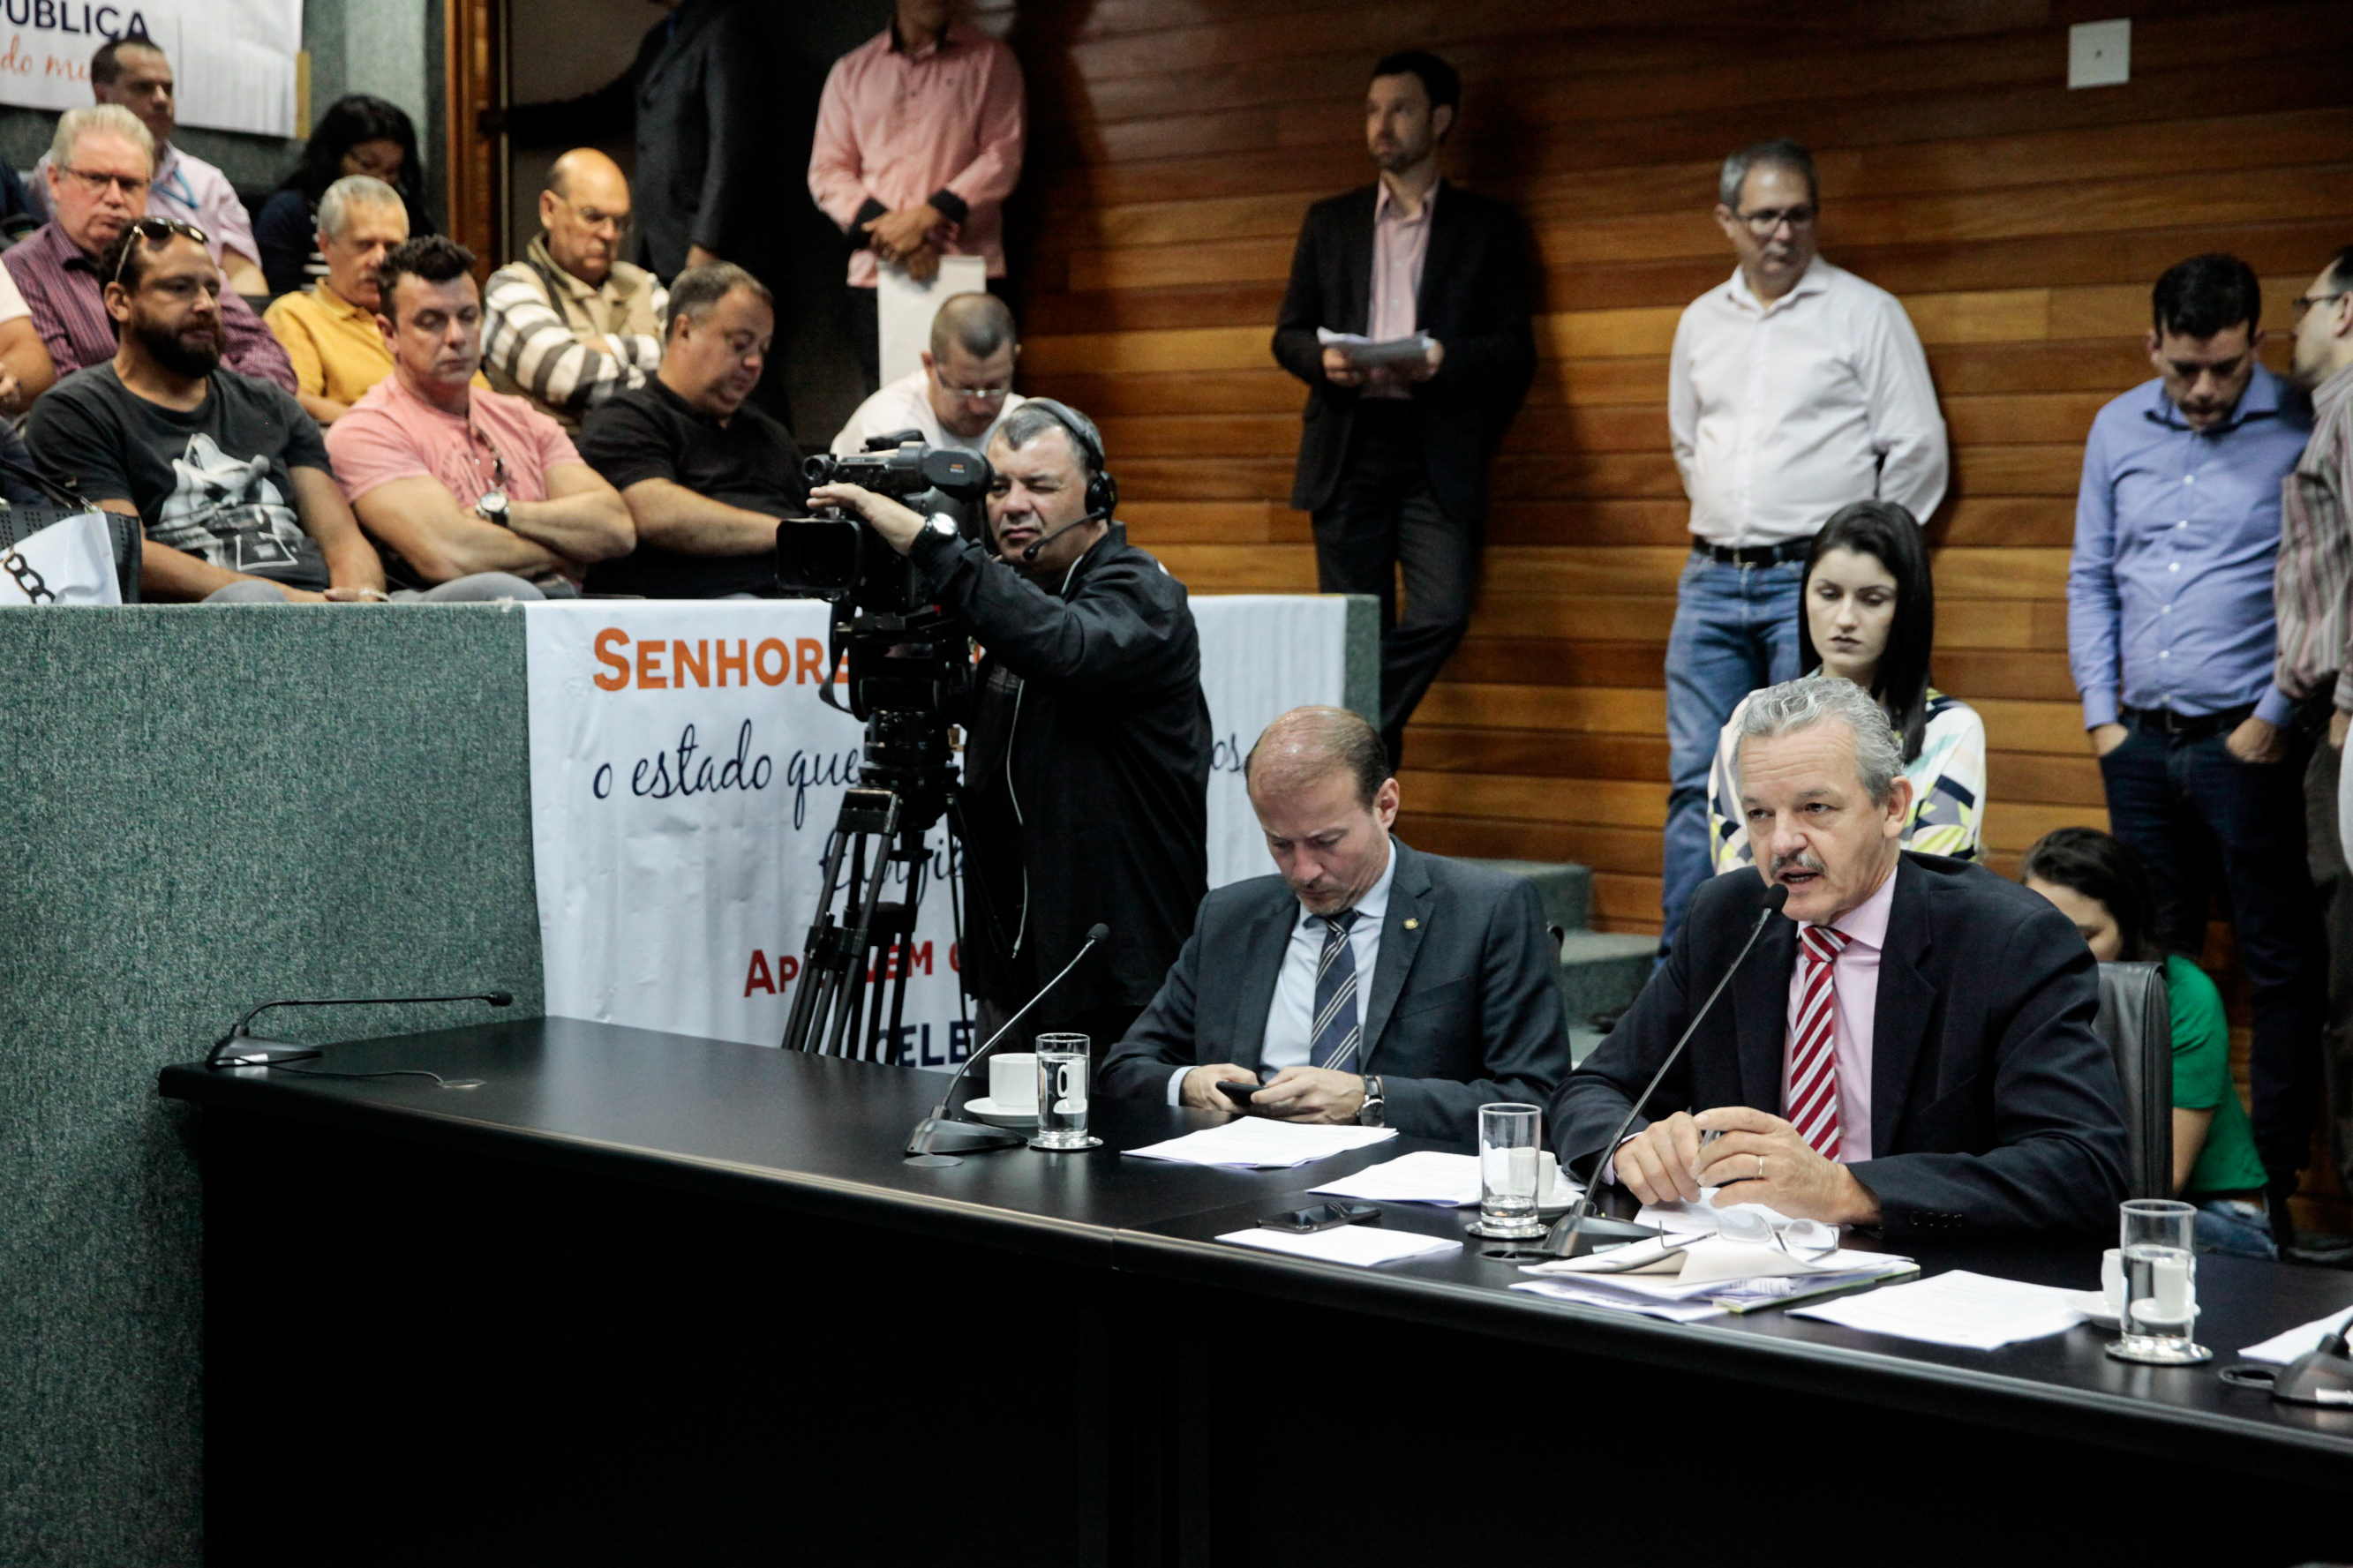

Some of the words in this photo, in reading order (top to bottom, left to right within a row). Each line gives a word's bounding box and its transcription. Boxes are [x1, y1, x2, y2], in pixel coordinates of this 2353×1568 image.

[0, 0, 148, 41] UBLICA
[593, 762, 613, 799] o
[632, 718, 772, 799] estado
[787, 747, 858, 830] que
